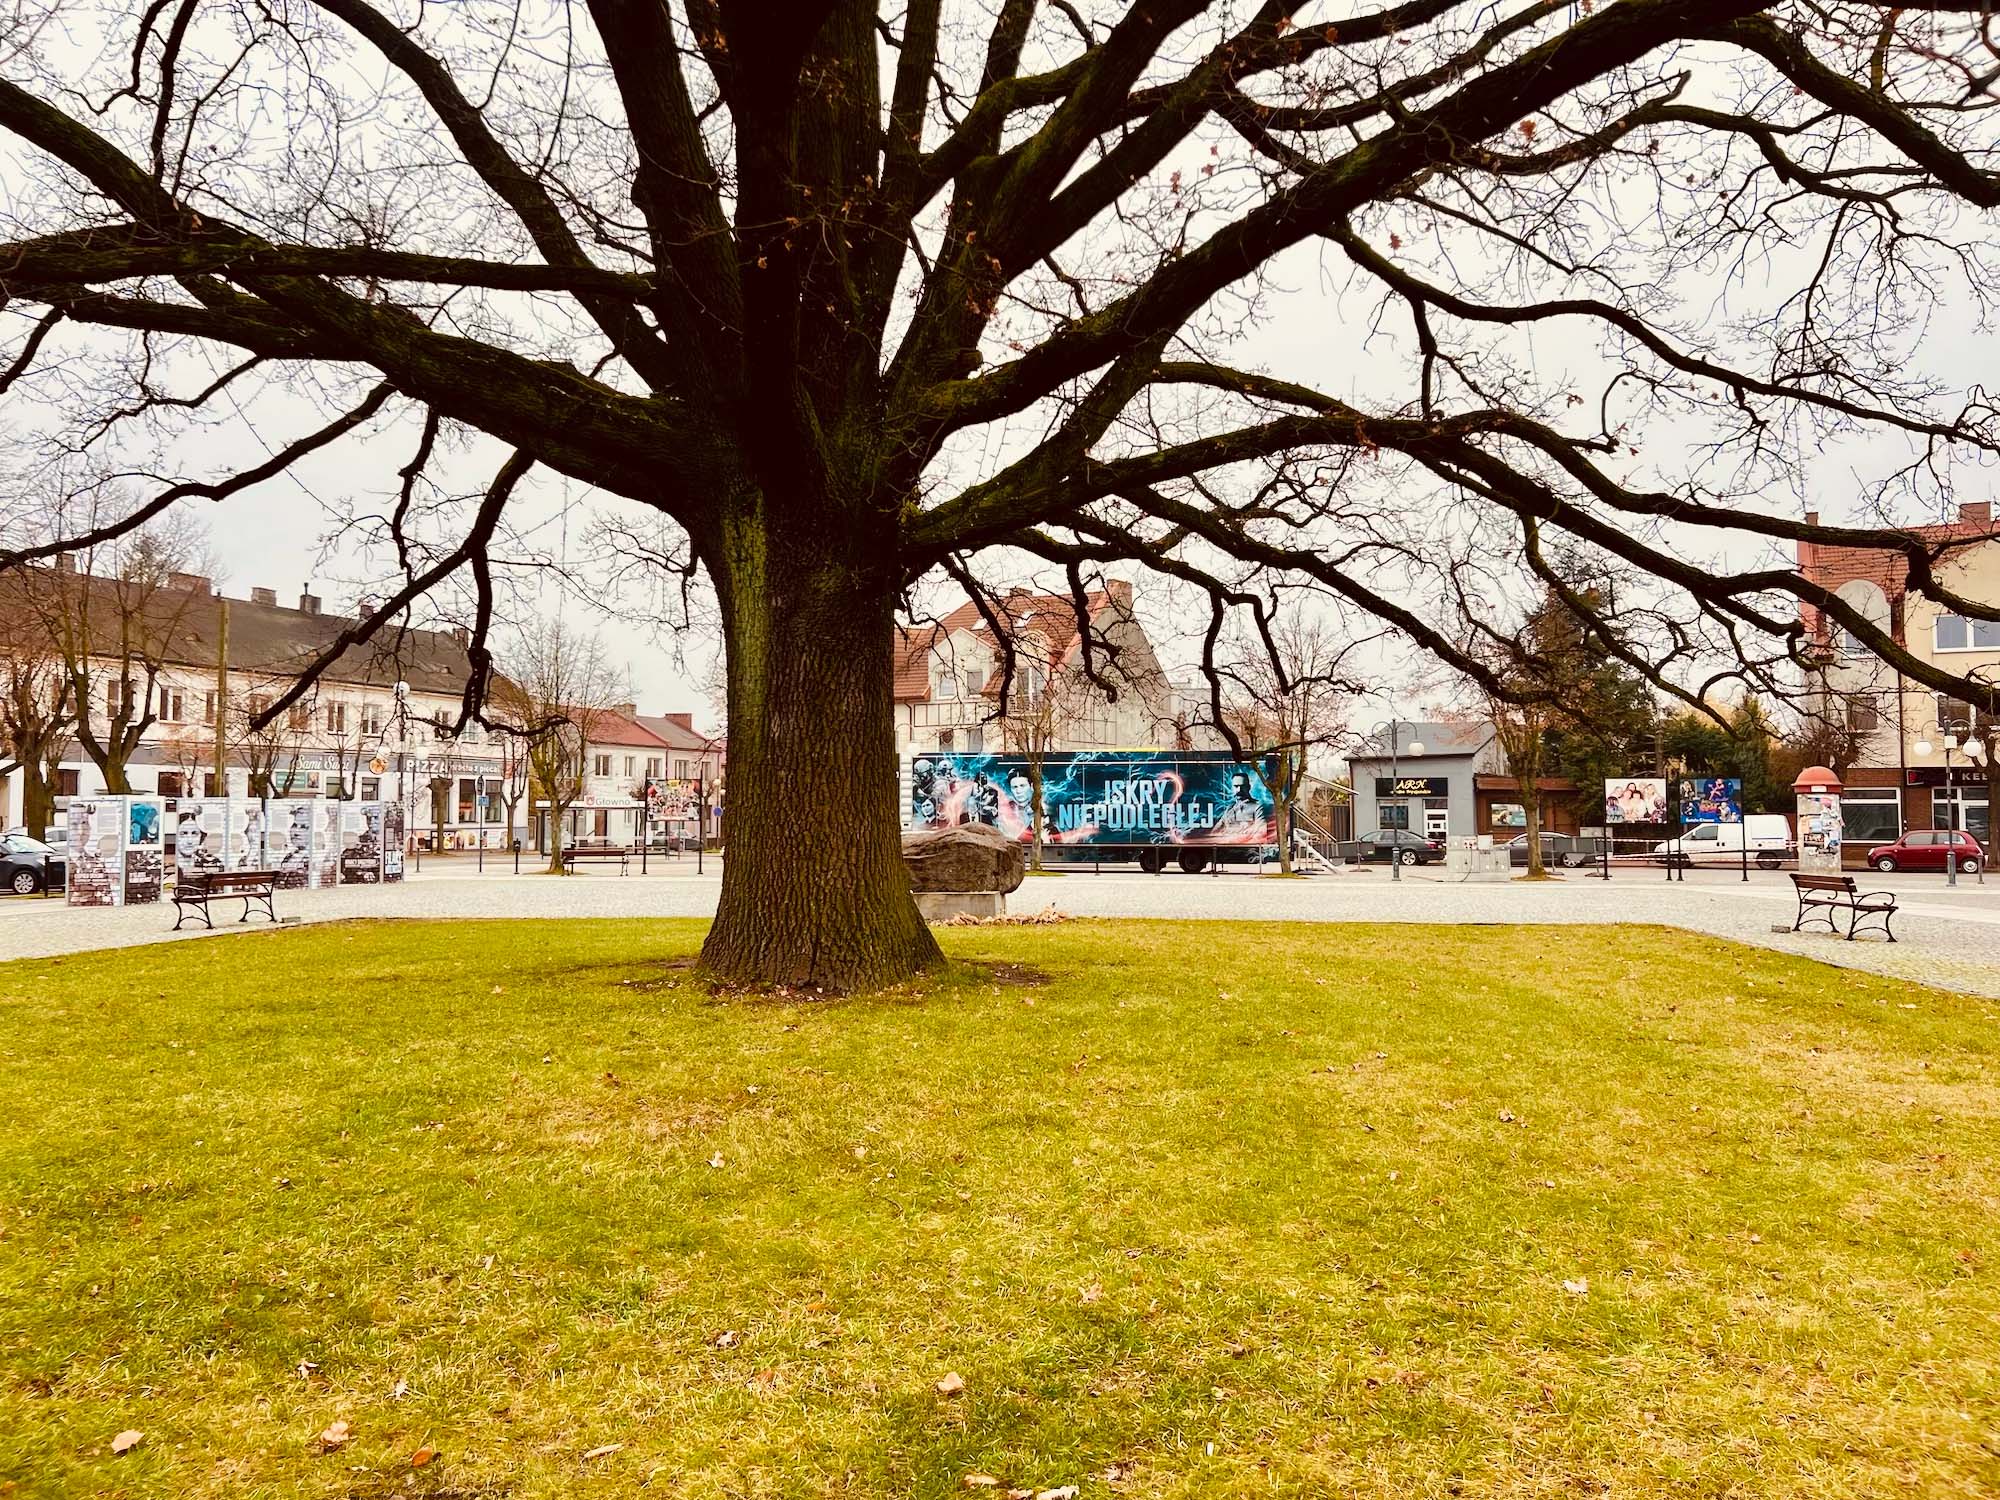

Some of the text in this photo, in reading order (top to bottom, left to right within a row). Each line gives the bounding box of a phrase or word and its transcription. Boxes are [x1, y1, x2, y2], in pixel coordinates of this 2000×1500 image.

[296, 754, 321, 770] Sami
[406, 760, 448, 773] PIZZA
[1104, 779, 1168, 805] ISKRY
[1058, 803, 1214, 829] NIEPODLEGŁEJ
